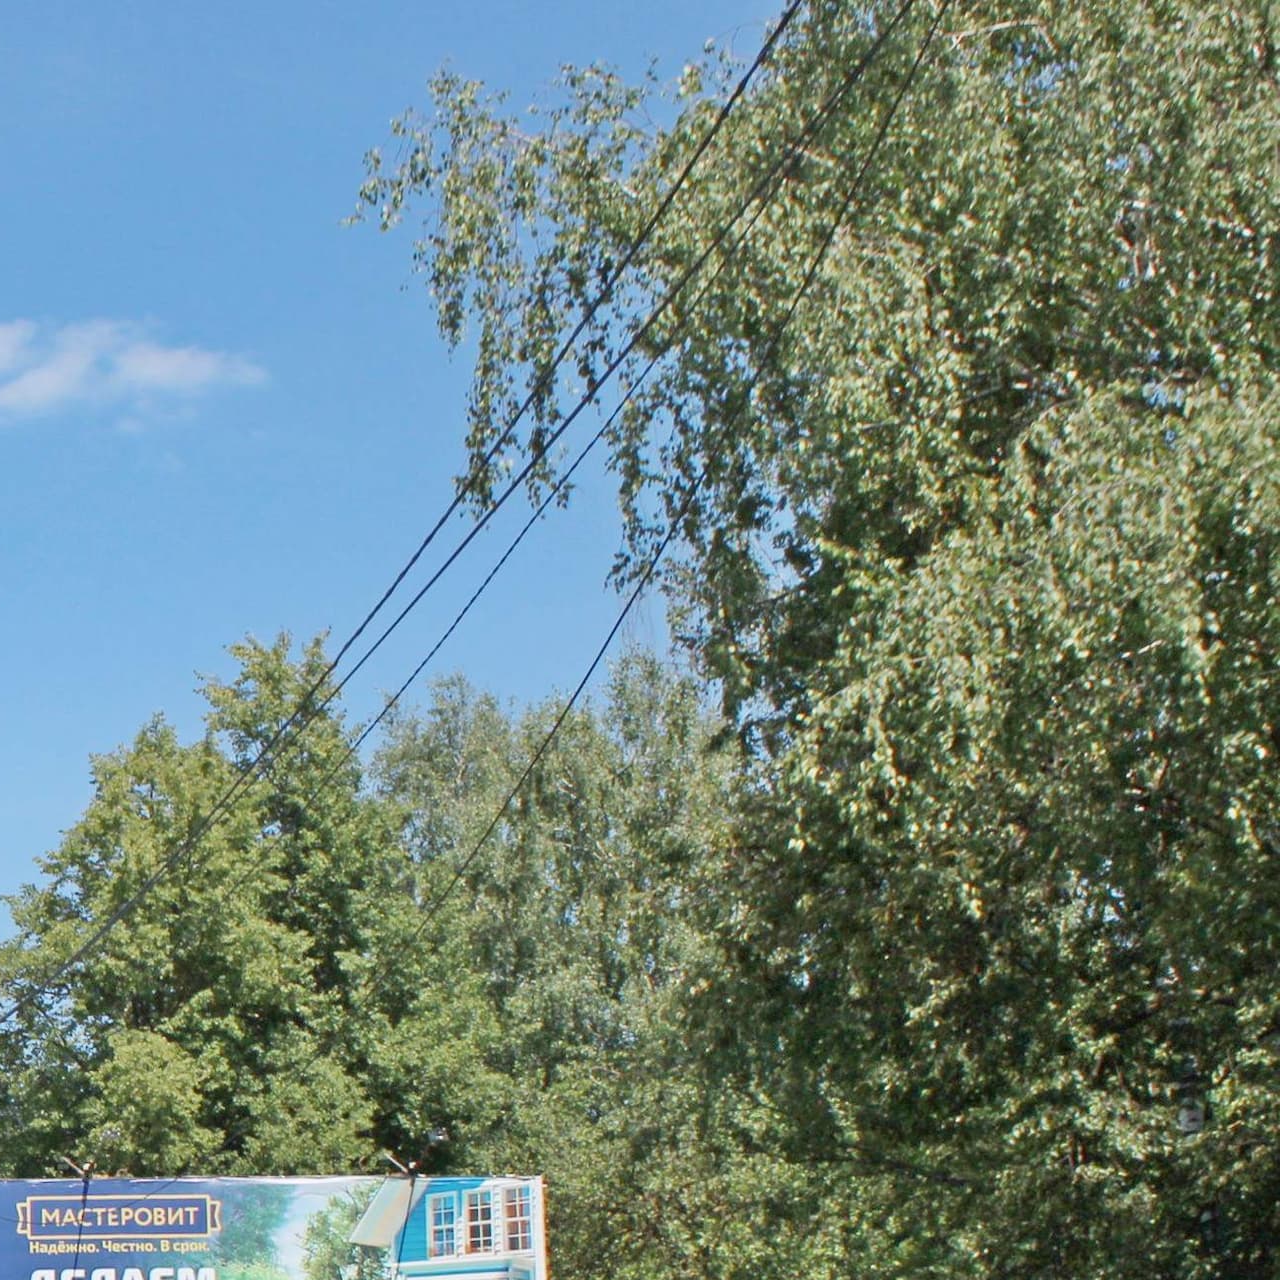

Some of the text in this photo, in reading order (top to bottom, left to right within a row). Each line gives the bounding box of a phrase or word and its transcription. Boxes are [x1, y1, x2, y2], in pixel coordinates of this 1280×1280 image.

[41, 1206, 200, 1228] МАСТЕРОВИТ
[29, 1239, 211, 1255] Надёжно. Честно. В срок.
